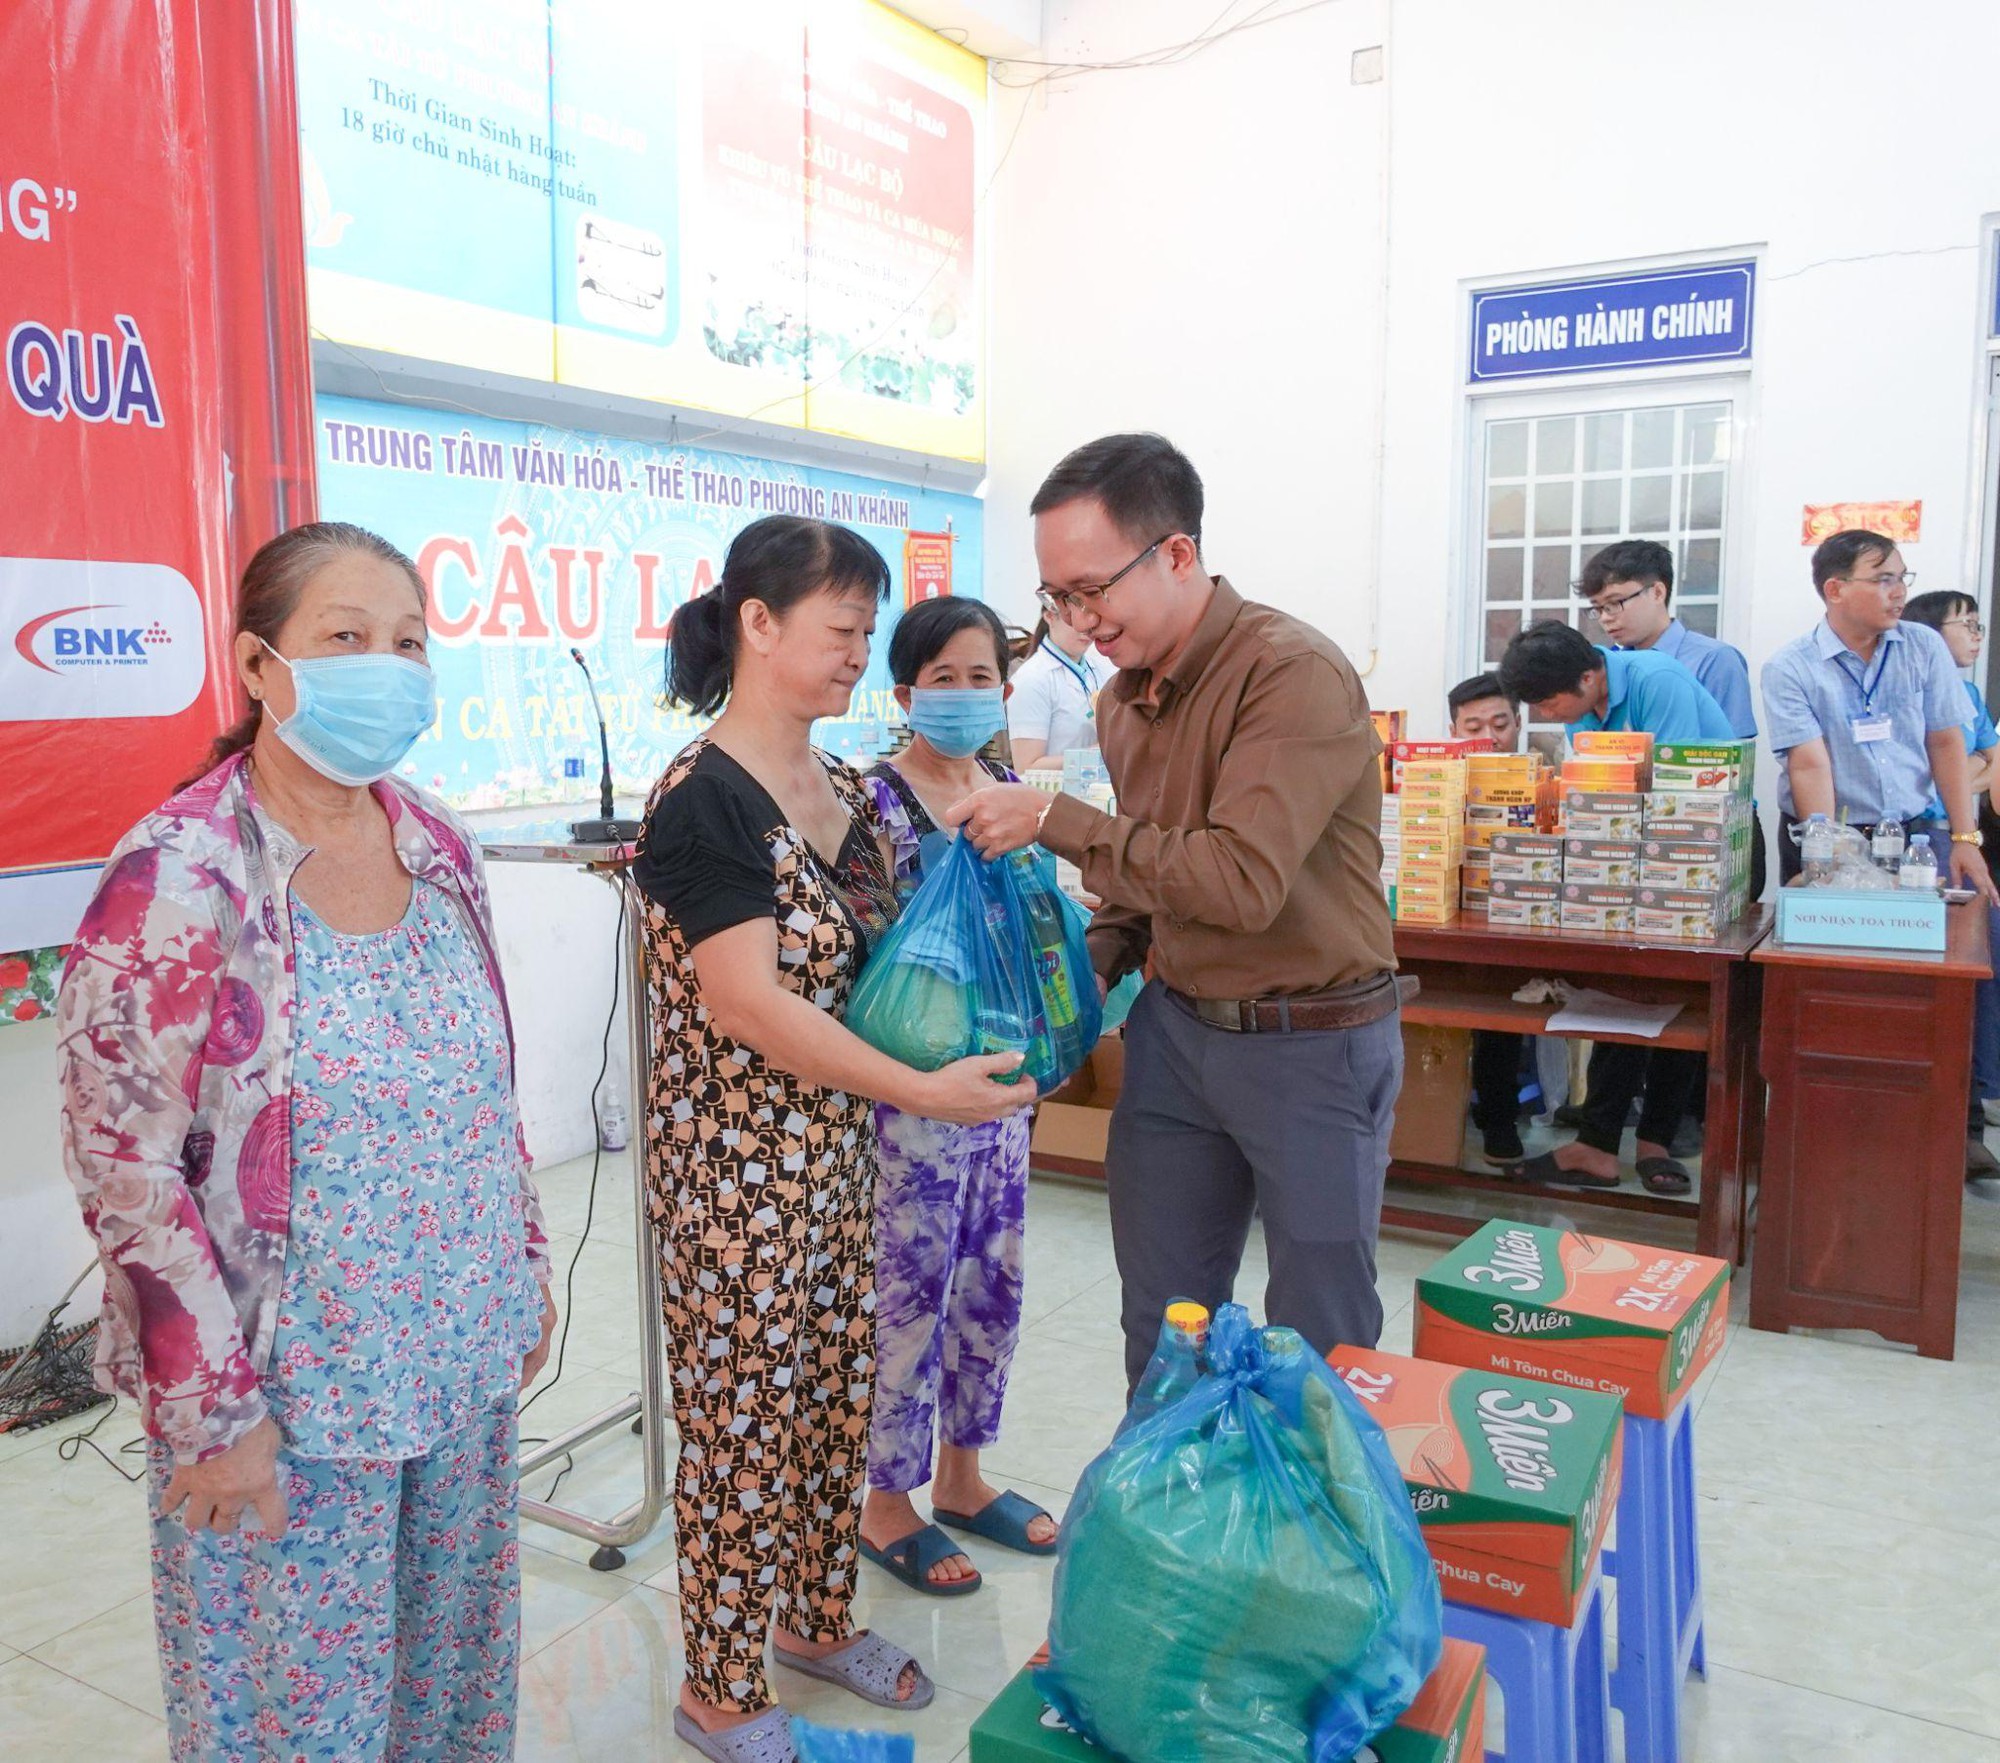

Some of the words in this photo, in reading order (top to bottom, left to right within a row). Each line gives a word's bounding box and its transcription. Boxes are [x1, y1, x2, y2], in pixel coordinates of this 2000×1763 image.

[369, 78, 417, 113] Thời
[425, 98, 472, 132] Gian
[480, 118, 521, 149] Sinh
[529, 134, 577, 168] Hoạt:
[341, 107, 364, 132] 18
[372, 120, 405, 144] giờ
[412, 133, 448, 159] chủ
[457, 147, 500, 177] nhật
[508, 159, 552, 197] hàng
[559, 181, 597, 206] tuần
[1486, 311, 1568, 356] PHÒNG
[1575, 303, 1645, 348] HÀNH
[1652, 292, 1733, 340] CHÍNH
[8, 316, 163, 426] QUÀ
[325, 422, 432, 471] TRUNG
[441, 431, 504, 479] TÂM
[512, 440, 565, 487] VĂN
[574, 448, 623, 493] HÓA
[645, 455, 686, 500] THỂ
[691, 470, 743, 507] THAO
[750, 477, 825, 517] PHƯỜNG
[831, 491, 853, 521] AN
[859, 489, 909, 527] KHÁNH
[417, 514, 603, 640] CÂU
[54, 628, 147, 655] BNK
[55, 658, 102, 666] COMPUTER
[113, 658, 148, 666] PRINTER
[460, 696, 514, 741] CA
[1794, 914, 1816, 923] NƠI
[1820, 915, 1855, 928] NHẬN
[1859, 917, 1885, 927] TOA
[1889, 918, 1935, 930] THUỐC
[1615, 1286, 1669, 1312] 2X
[1490, 1354, 1510, 1368] Mì
[1513, 1359, 1549, 1379] Tôm
[1551, 1368, 1595, 1389] Chua
[1598, 1379, 1630, 1398] Cay
[1486, 1573, 1526, 1597] Cay
